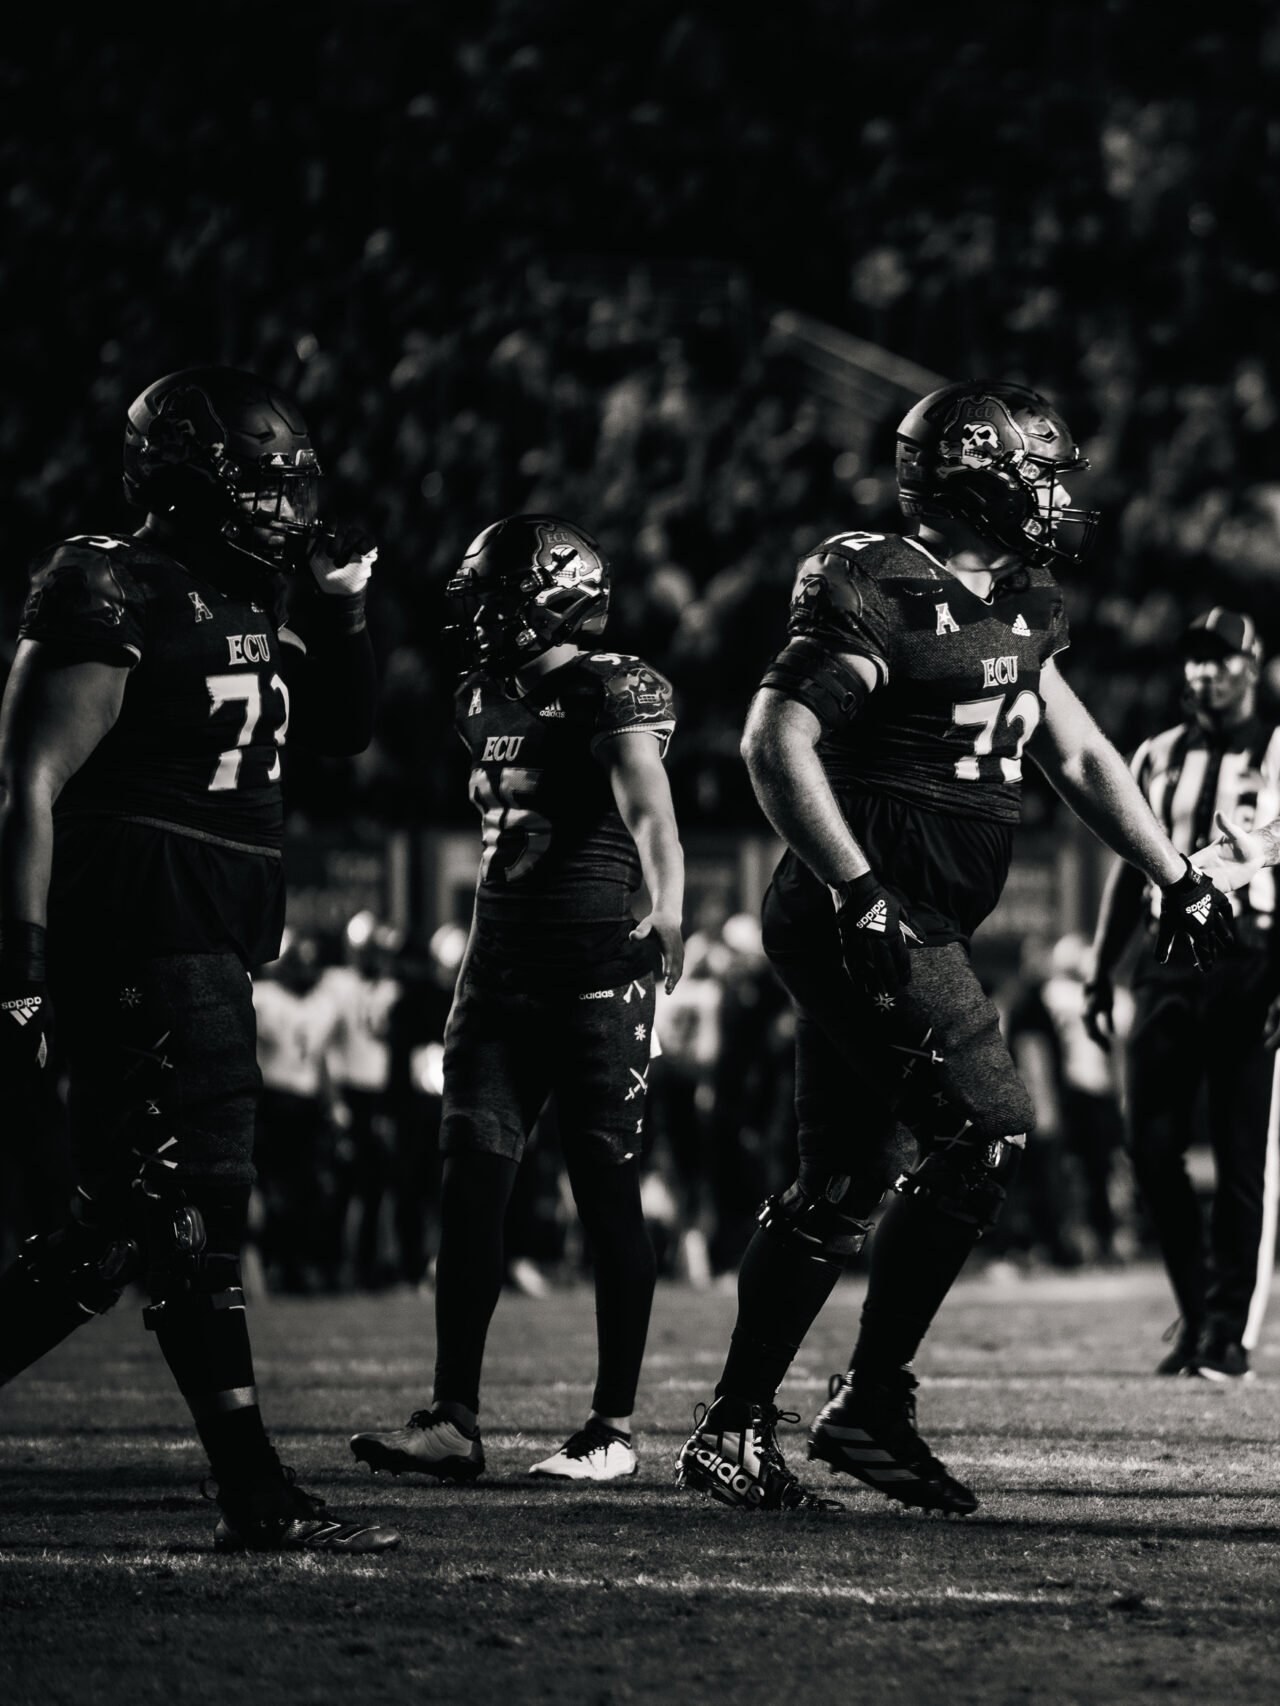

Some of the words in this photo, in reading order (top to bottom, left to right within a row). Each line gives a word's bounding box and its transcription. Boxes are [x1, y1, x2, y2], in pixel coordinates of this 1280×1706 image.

[966, 407, 997, 418] ECU
[546, 533, 569, 544] ECU
[226, 634, 271, 666] ECU
[981, 656, 1018, 689] ECU
[480, 734, 525, 762] ECU
[943, 689, 1040, 784] 72
[856, 899, 886, 929] adidas
[1, 996, 42, 1010] adidas
[579, 989, 615, 1000] adidas
